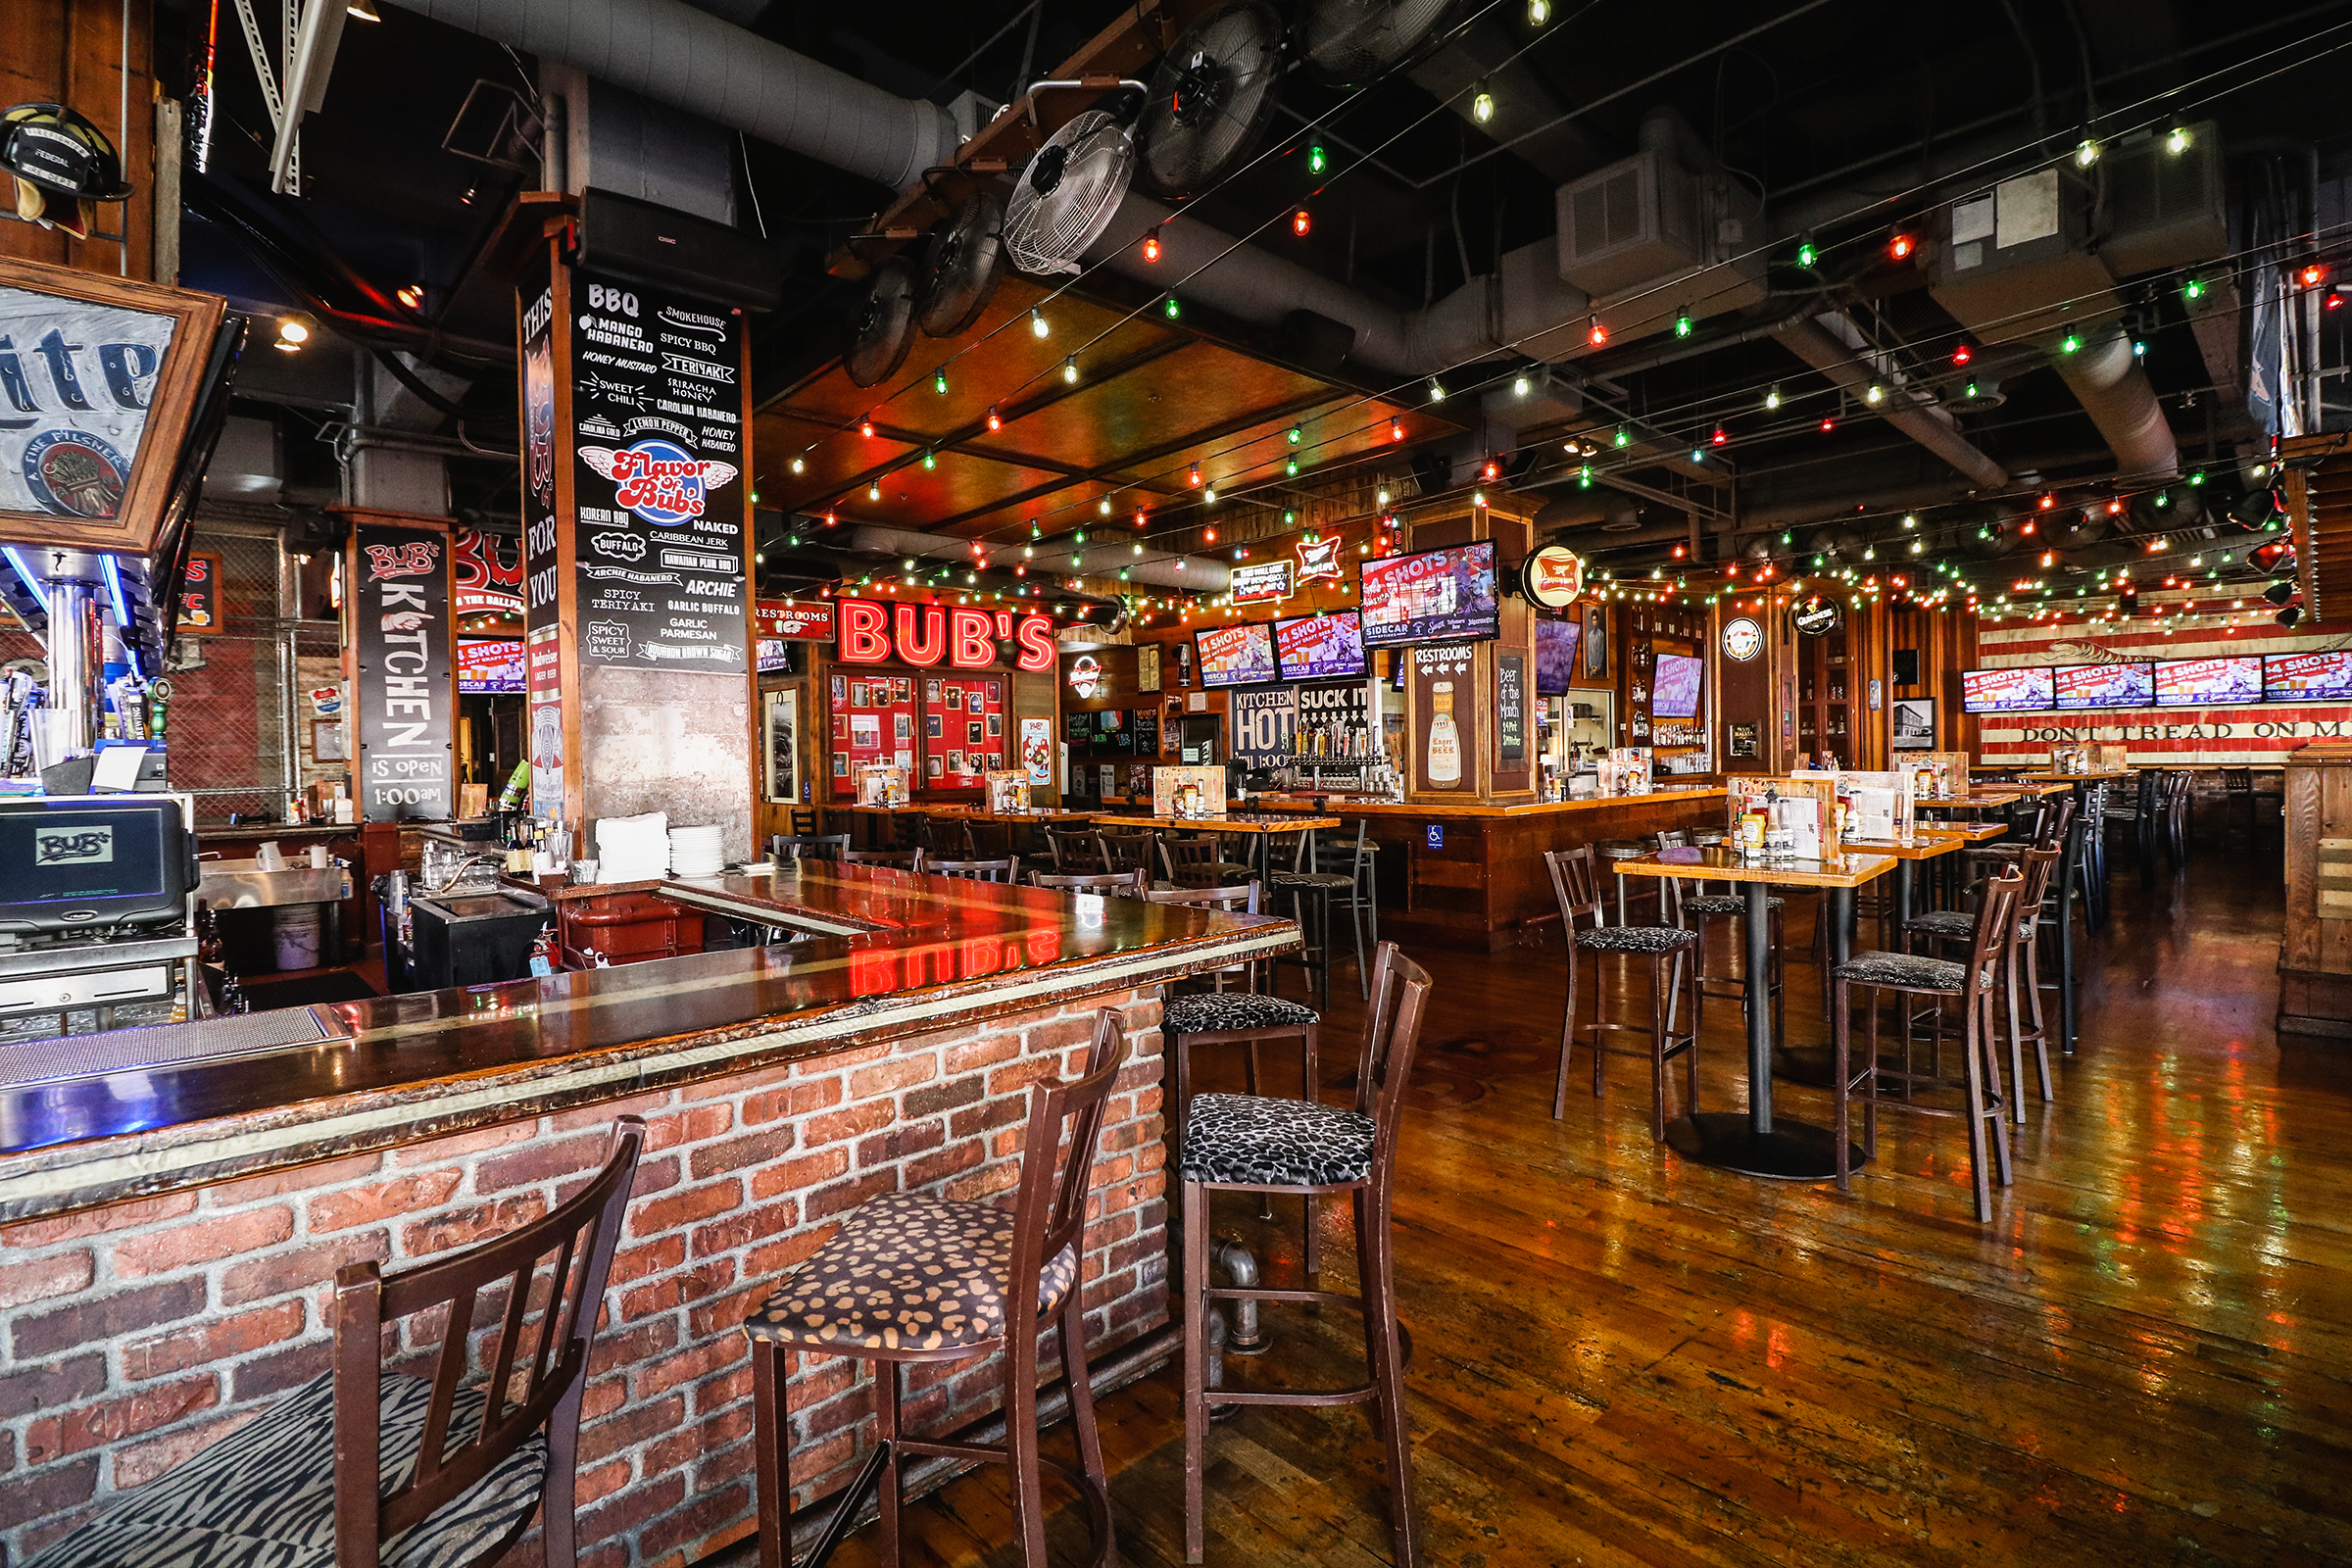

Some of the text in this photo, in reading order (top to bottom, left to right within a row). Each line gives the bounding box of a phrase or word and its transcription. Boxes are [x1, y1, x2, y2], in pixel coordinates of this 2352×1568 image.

[35, 148, 70, 168] FEDERAL
[48, 173, 73, 187] DEPT
[588, 283, 639, 318] BBQ
[522, 286, 552, 344] THIS
[665, 306, 726, 330] SMOKEHOUSE
[598, 318, 643, 338] MANGO
[587, 328, 654, 354] HABANERO
[661, 332, 716, 355] SPICY BBQ
[0, 327, 157, 416] ite
[582, 351, 657, 374] HONEY MUSTARD
[671, 356, 725, 379] TERIYAKI
[599, 379, 634, 395] SWEET
[667, 378, 716, 396] SRIRACHA
[672, 388, 712, 403] HONEY
[608, 393, 635, 406] CHILI
[657, 399, 736, 424] CAROLINA HABANERO
[578, 422, 620, 438] CAROLINA GOLD
[632, 417, 689, 438] LEMON PEPPER
[702, 425, 735, 441] HONEY
[702, 438, 736, 453] HABANERO
[612, 450, 710, 479] Flavor
[661, 476, 681, 491] Of
[615, 477, 705, 516] Bub's
[580, 507, 629, 525] KOREAN BBQ
[694, 519, 738, 535] NAKED
[528, 514, 557, 562] FOR
[600, 540, 638, 552] BUFFALO
[650, 530, 728, 547] CARIBBEAN JERK
[365, 541, 441, 572] BUB'S
[664, 554, 731, 571] HAWAIIAN PLUM BBQ
[594, 568, 672, 582] ARCHIE HABANERO
[1384, 551, 1447, 584] SHOTS
[530, 565, 558, 610] YOU
[604, 589, 641, 601] SPICY
[686, 580, 736, 598] ARCHIE
[464, 595, 523, 610] THE BALLPA
[592, 599, 655, 612] TERIYAKI
[668, 600, 740, 615] GARLIC BUFFALO
[669, 617, 708, 629] GARLIC
[756, 608, 828, 622] RESTROOMS
[591, 625, 624, 636] SPICY
[661, 628, 716, 640] PARMESAN
[838, 598, 1055, 672] BUB'S
[1291, 615, 1331, 640] SHOTS
[1366, 624, 1408, 636] SIDECAR
[592, 637, 625, 646] SWEET
[1210, 627, 1245, 650] SHOTS
[467, 642, 520, 659] SHOTS
[531, 649, 558, 668] Budweiser
[602, 646, 626, 655] SOUR
[648, 644, 732, 662] BOURBON BROWN SUGAR
[1415, 646, 1472, 663] RESTROOMS
[2174, 660, 2226, 677] SHOTS
[2285, 652, 2342, 670] SHOTS
[535, 668, 557, 682] LAGER BEER
[1499, 667, 1517, 684] Beer
[1979, 669, 2022, 685] SHOTS
[2072, 664, 2119, 681] SHOTS
[1237, 690, 1294, 710] KITCHEN
[1300, 688, 1368, 710] SUCK IT
[1500, 684, 1519, 700] of the
[1499, 700, 1519, 719] Month
[132, 707, 145, 740] BREWING
[1238, 707, 1294, 751] HOT
[2116, 722, 2232, 741] TREAD
[2254, 723, 2298, 738] ON
[2314, 721, 2352, 737] M
[37, 831, 112, 857] BUB'S
